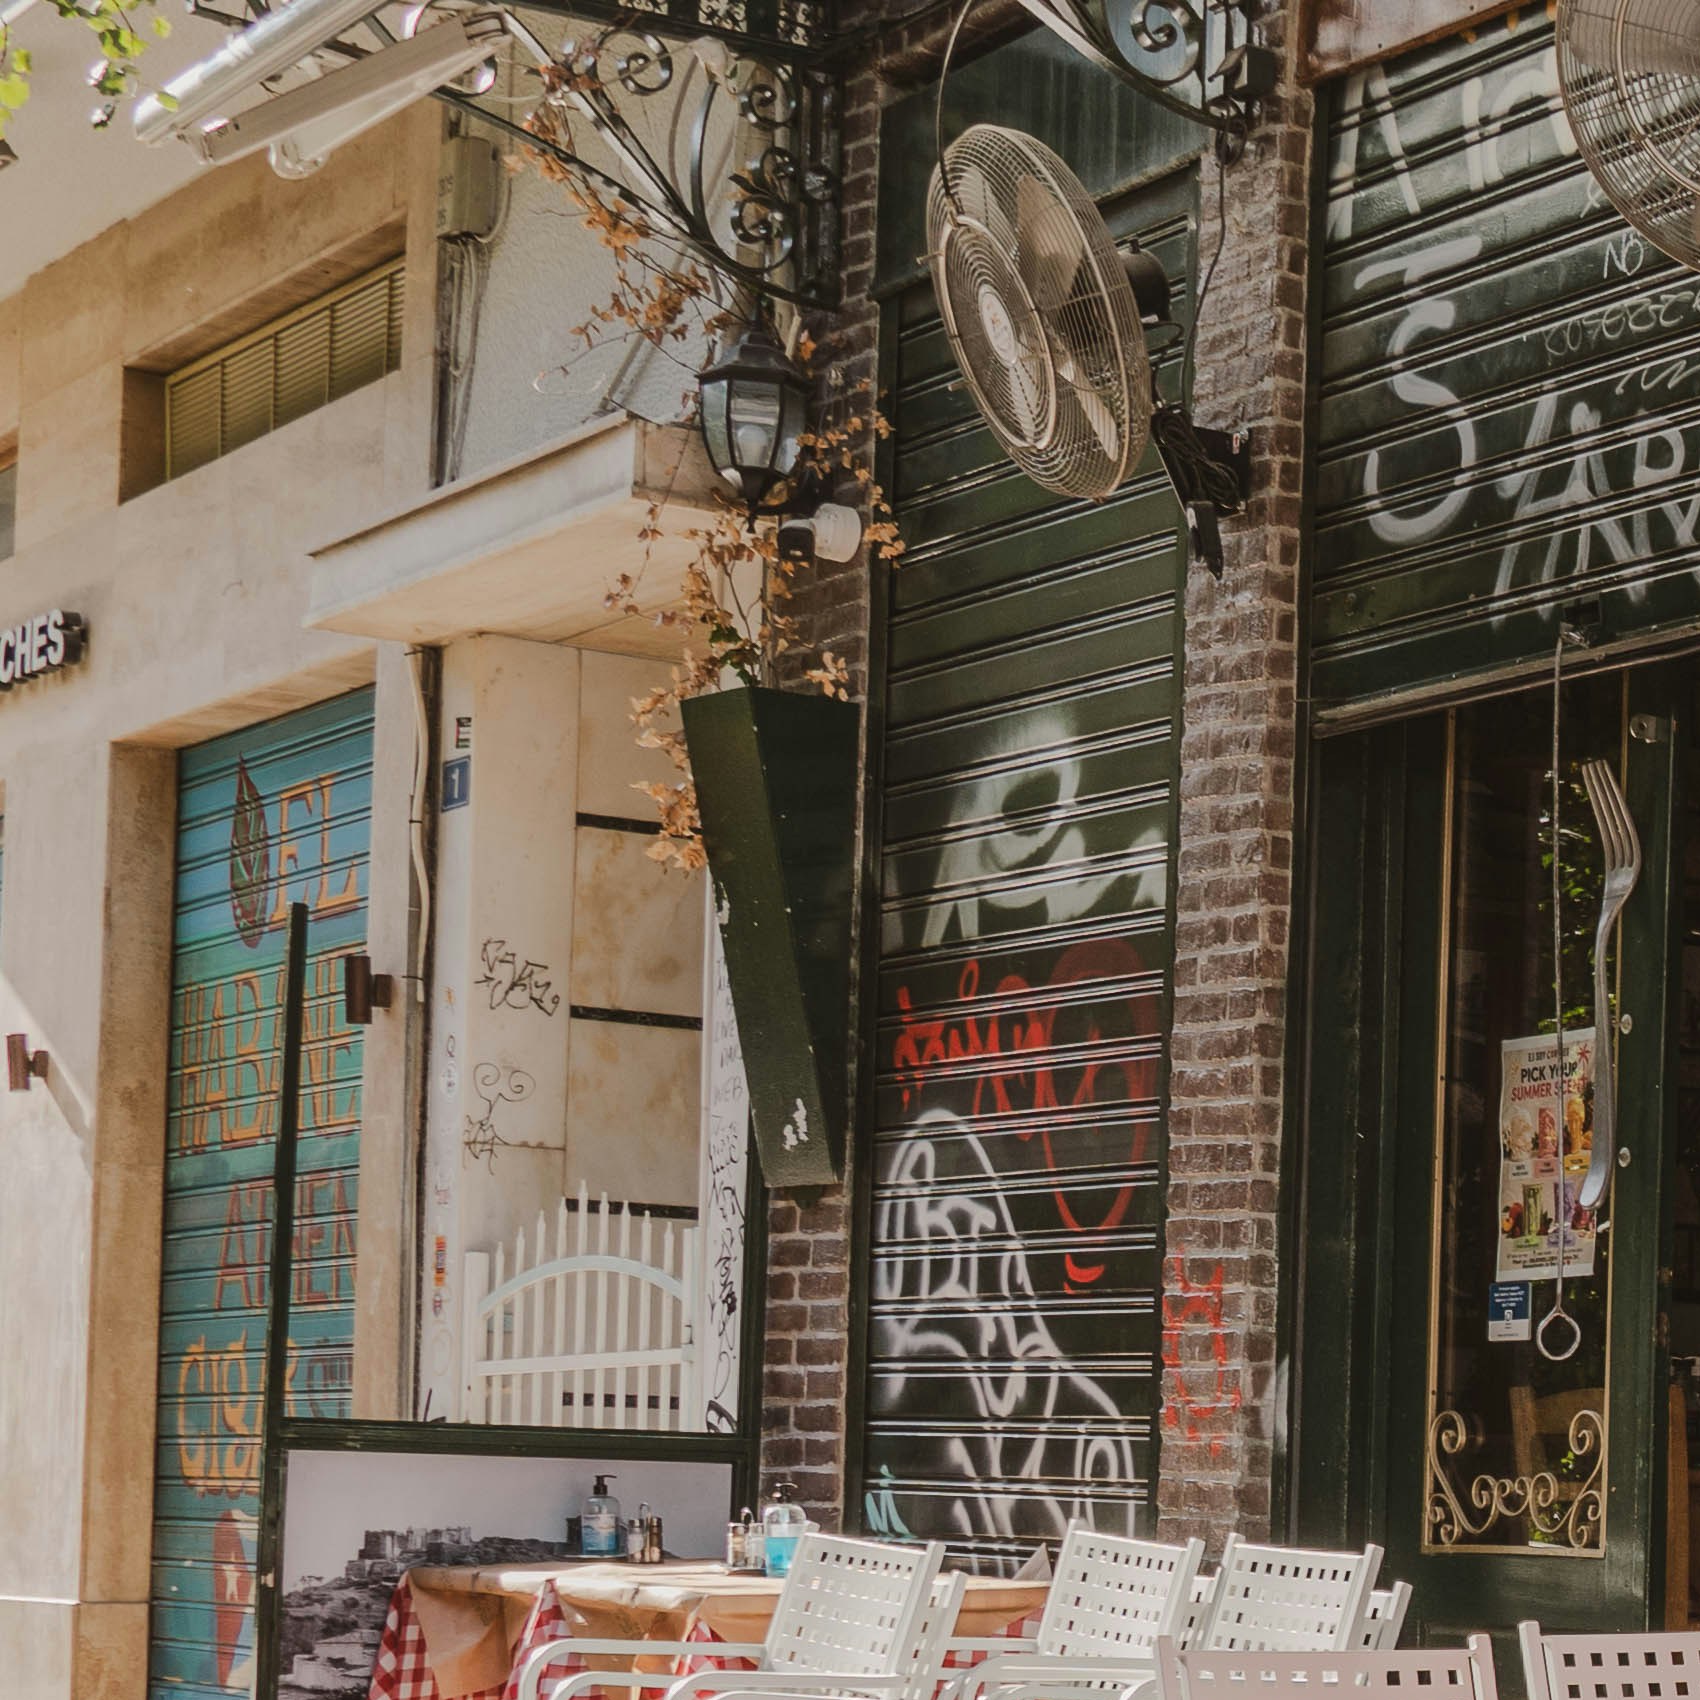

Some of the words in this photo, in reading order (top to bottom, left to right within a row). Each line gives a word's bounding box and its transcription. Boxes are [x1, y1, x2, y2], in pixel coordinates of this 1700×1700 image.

[451, 767, 460, 799] 1
[270, 771, 360, 931] EL
[1520, 1066, 1546, 1084] PICK
[1511, 1082, 1552, 1102] SUMMER
